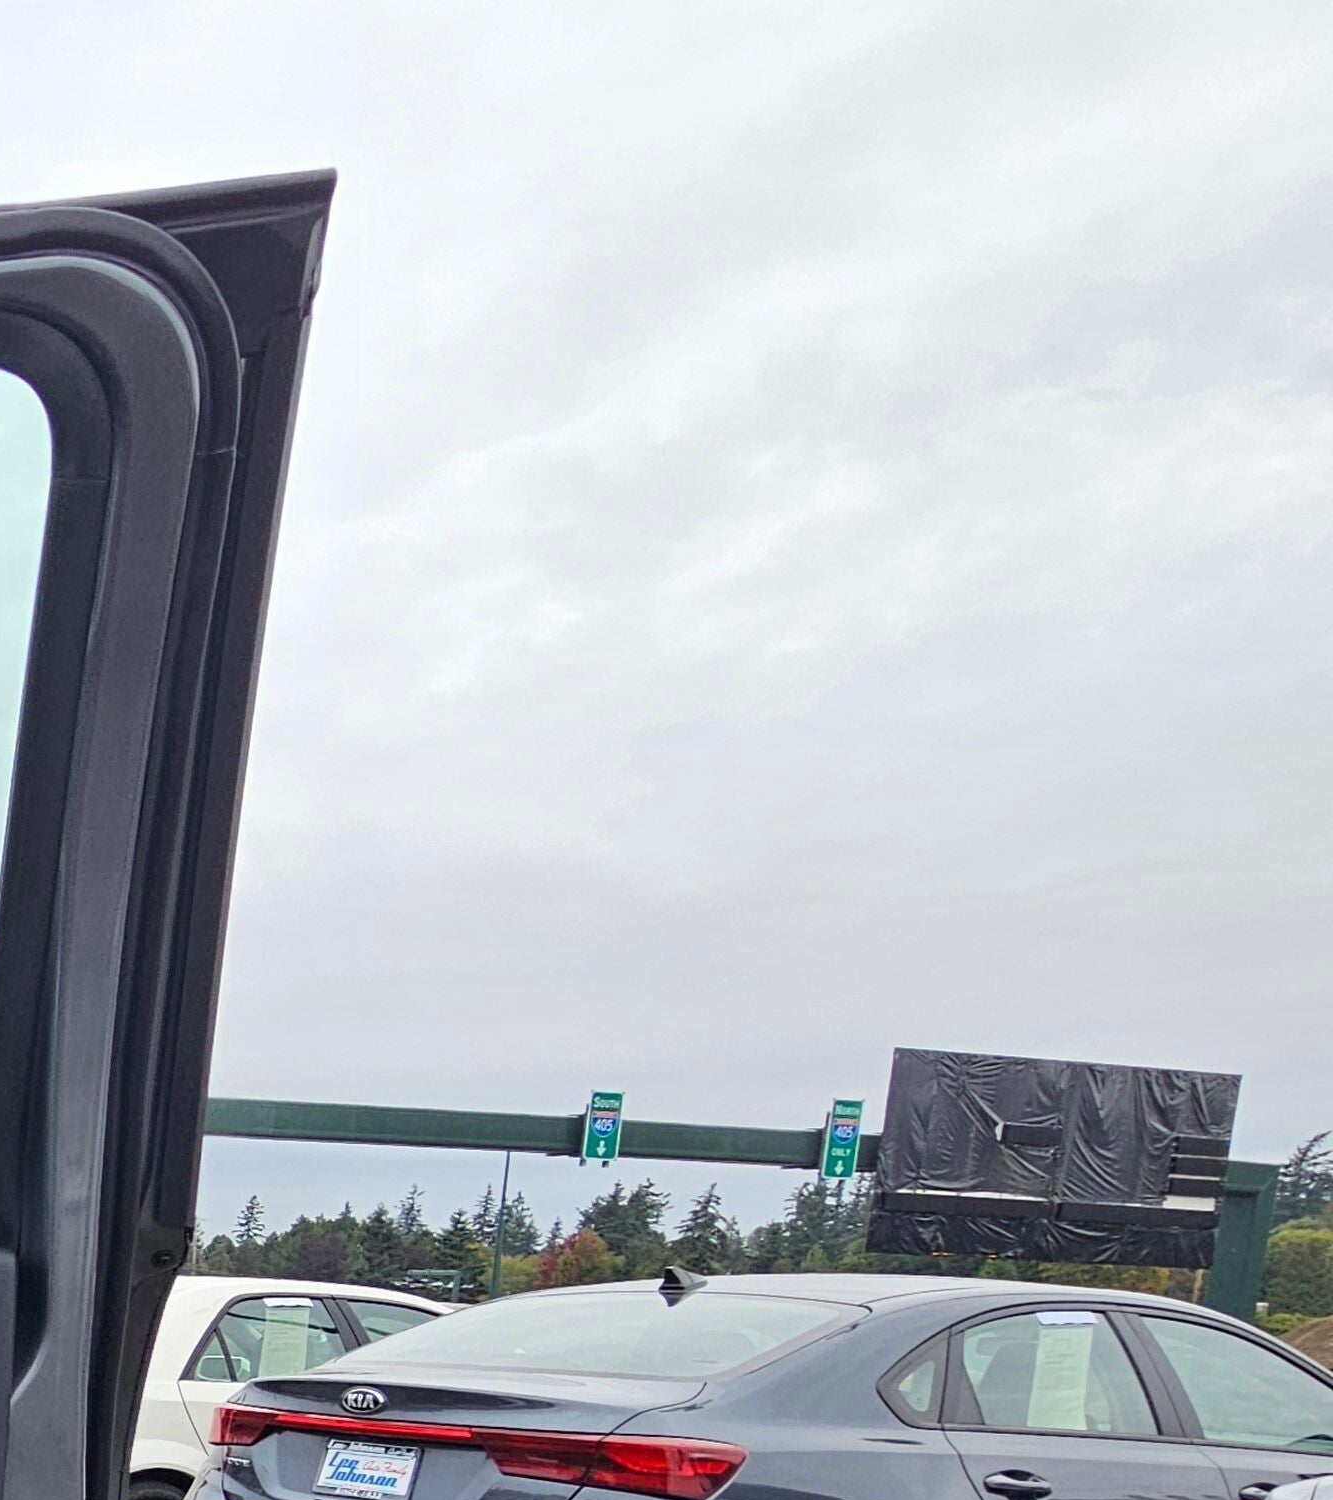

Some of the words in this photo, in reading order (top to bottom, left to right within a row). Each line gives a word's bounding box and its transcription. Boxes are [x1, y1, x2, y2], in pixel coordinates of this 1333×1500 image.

[593, 1096, 620, 1108] SOUTH
[594, 1118, 613, 1132] 405
[835, 1125, 853, 1138] 405
[347, 1393, 375, 1408] KIA
[328, 1451, 360, 1469] Lee
